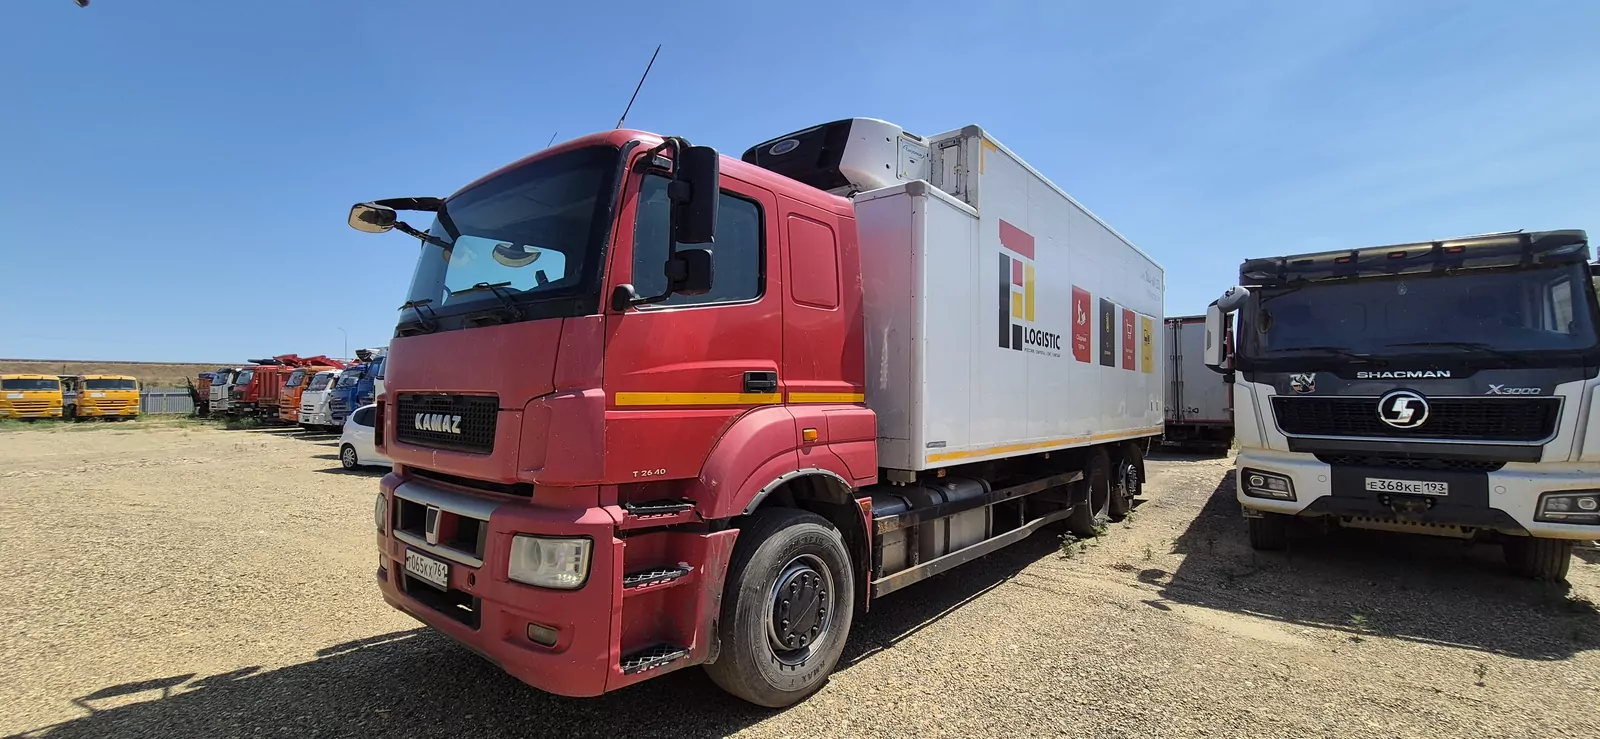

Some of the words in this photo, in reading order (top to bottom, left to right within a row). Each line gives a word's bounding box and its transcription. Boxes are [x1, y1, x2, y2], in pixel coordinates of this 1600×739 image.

[1024, 327, 1060, 350] LOGISTIC
[1356, 370, 1451, 379] SHACMAN
[1484, 384, 1542, 395] X3000
[415, 412, 462, 434] KAMAZ
[1423, 483, 1444, 491] 193
